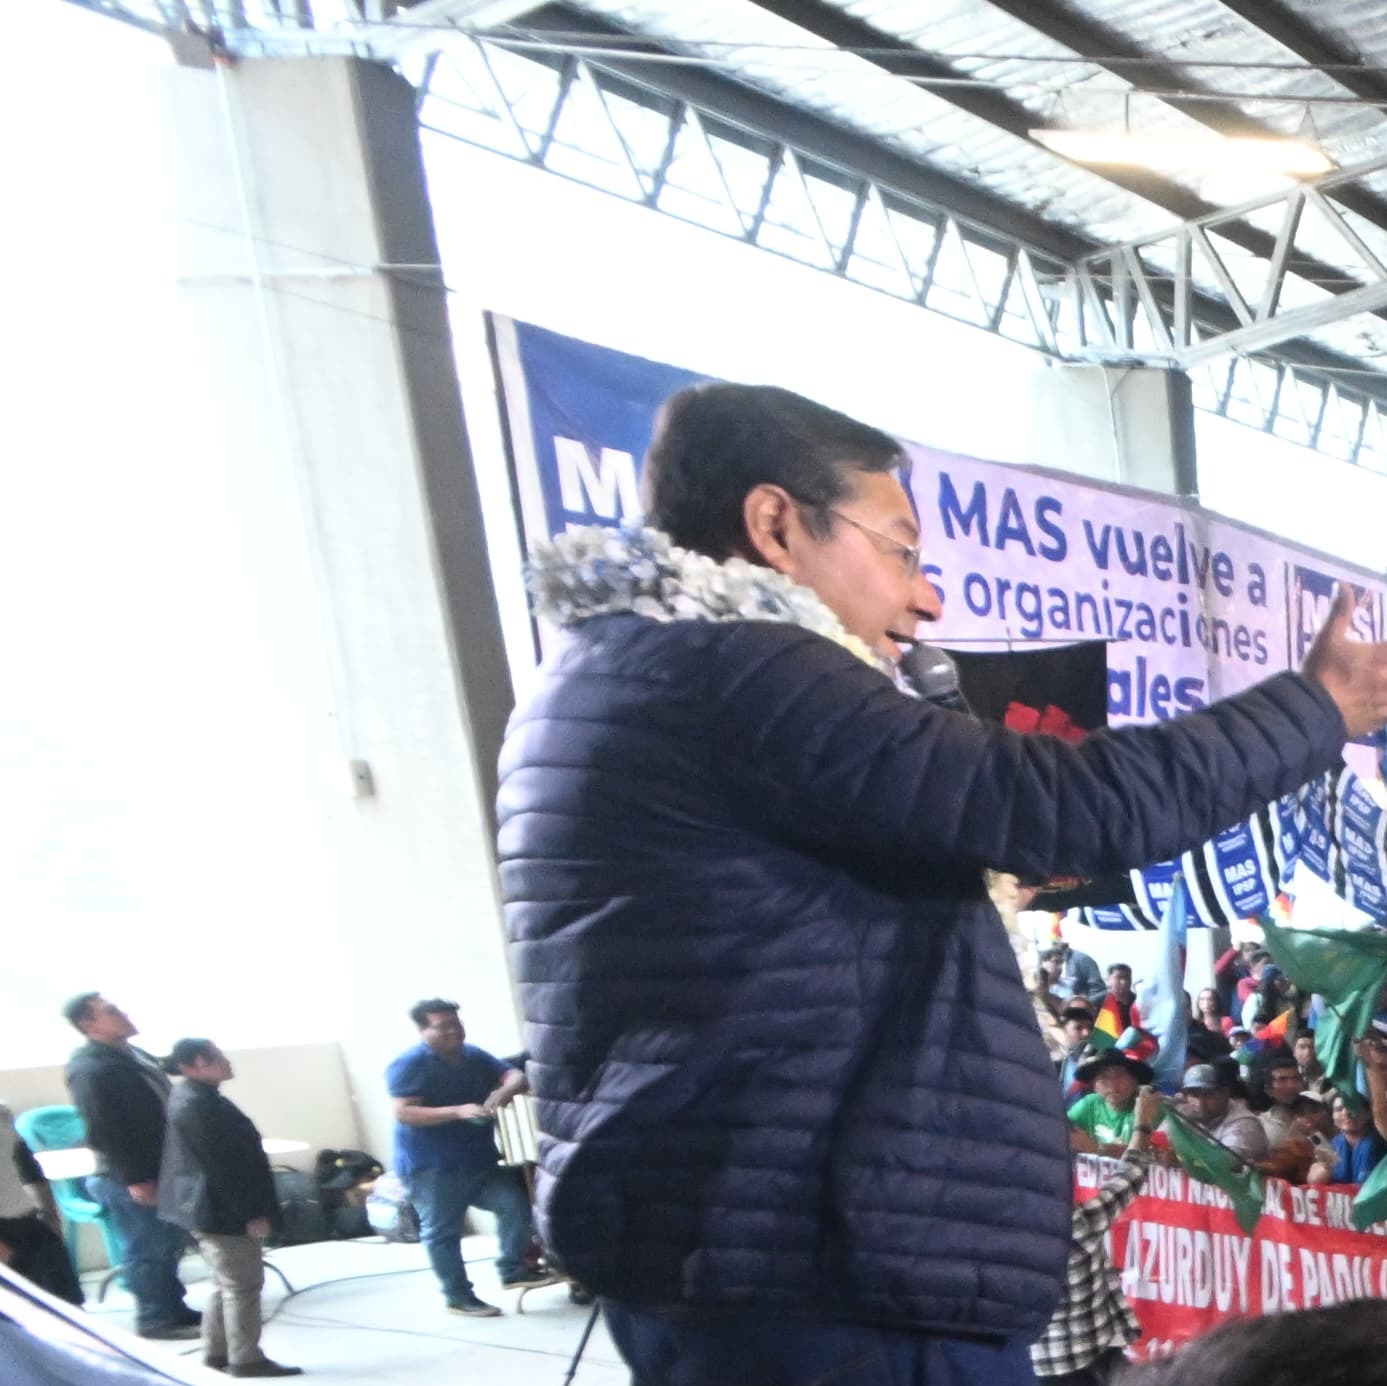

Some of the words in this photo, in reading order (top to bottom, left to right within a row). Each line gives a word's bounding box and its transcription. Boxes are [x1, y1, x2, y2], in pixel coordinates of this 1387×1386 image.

[938, 472, 1068, 562] MAS
[1083, 522, 1235, 597] vuelve
[1247, 562, 1268, 608] a
[962, 572, 1269, 667] organizaciones
[1223, 858, 1257, 885] MAS
[1290, 1185, 1322, 1226] DE
[1122, 1220, 1250, 1314] AZURDUY
[1260, 1238, 1297, 1317] DE
